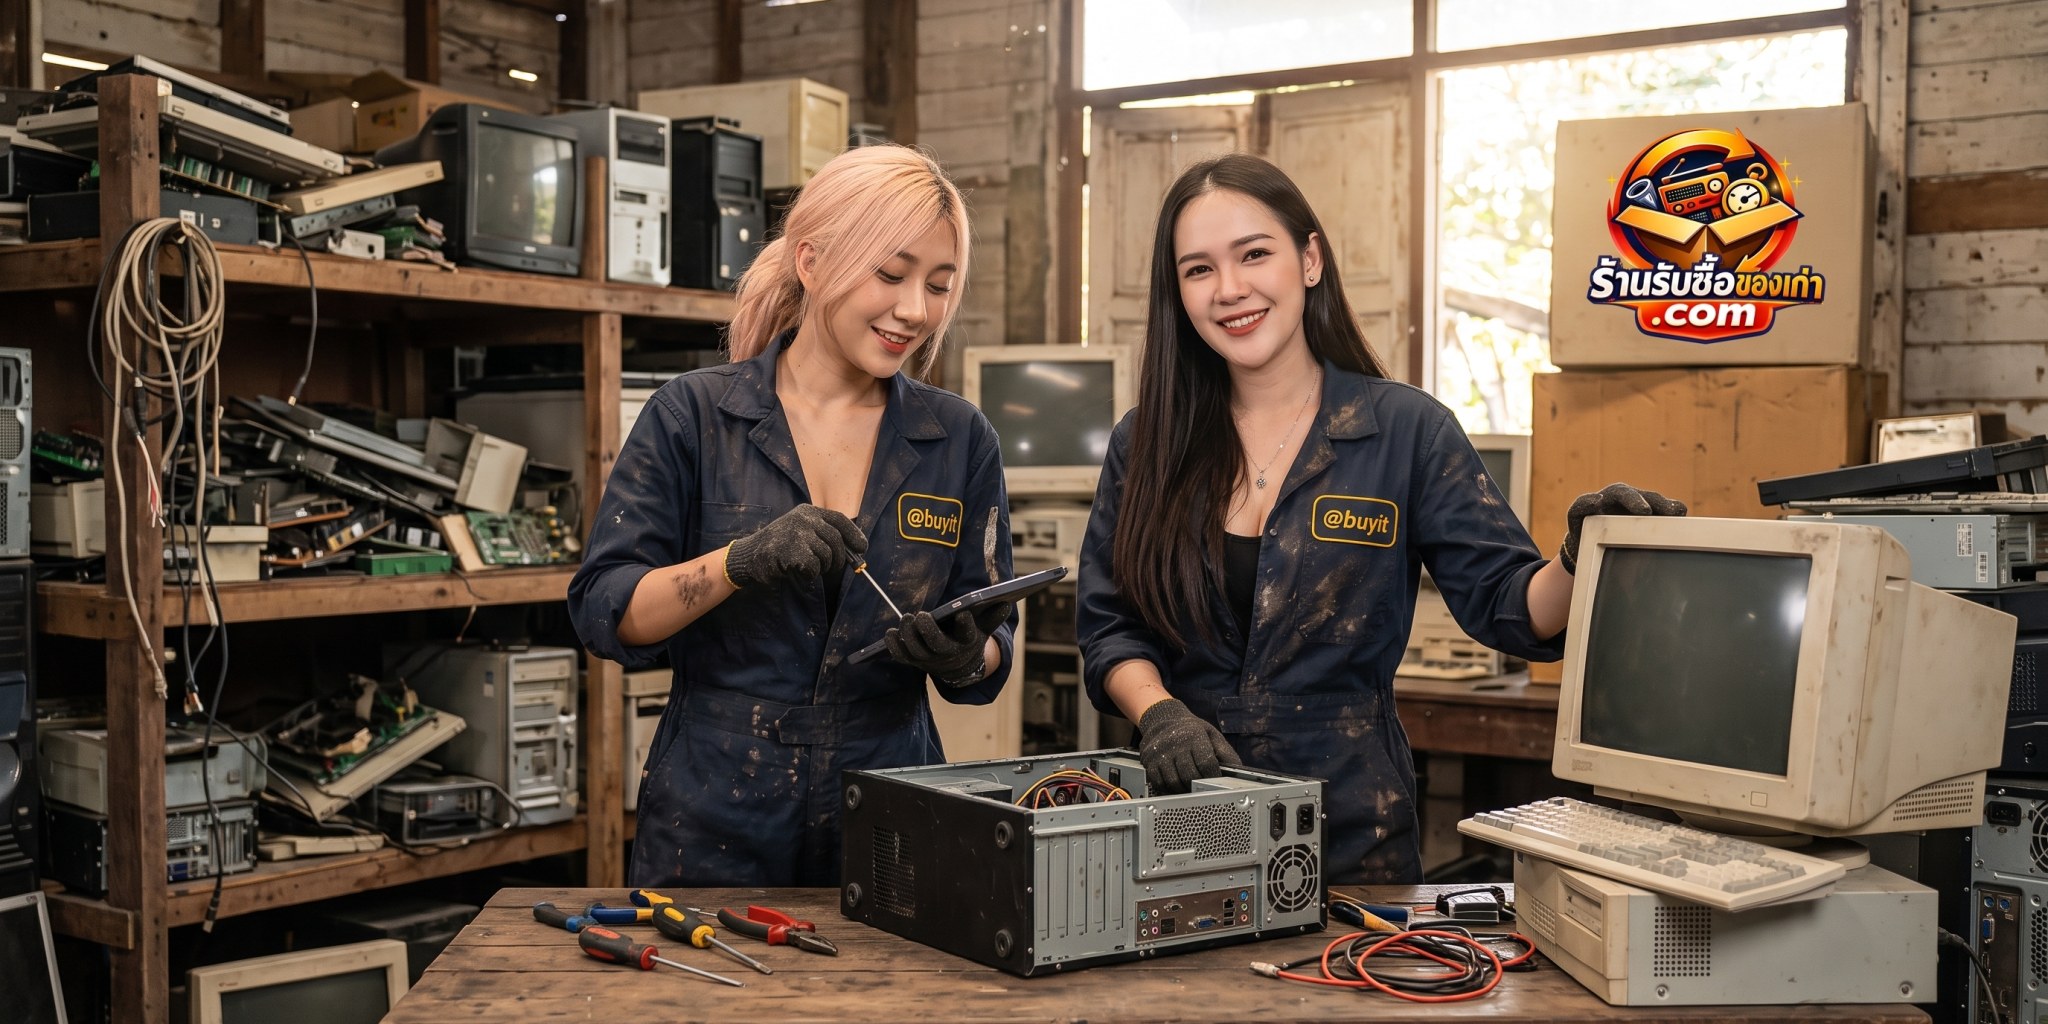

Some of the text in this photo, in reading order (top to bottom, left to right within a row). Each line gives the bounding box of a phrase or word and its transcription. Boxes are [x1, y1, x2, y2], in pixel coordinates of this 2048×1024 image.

[1590, 254, 1823, 299] ร้านรับซื้อของเก่า
[1651, 303, 1756, 327] .com
[907, 508, 957, 535] @buyit
[1323, 509, 1389, 536] @buyit
